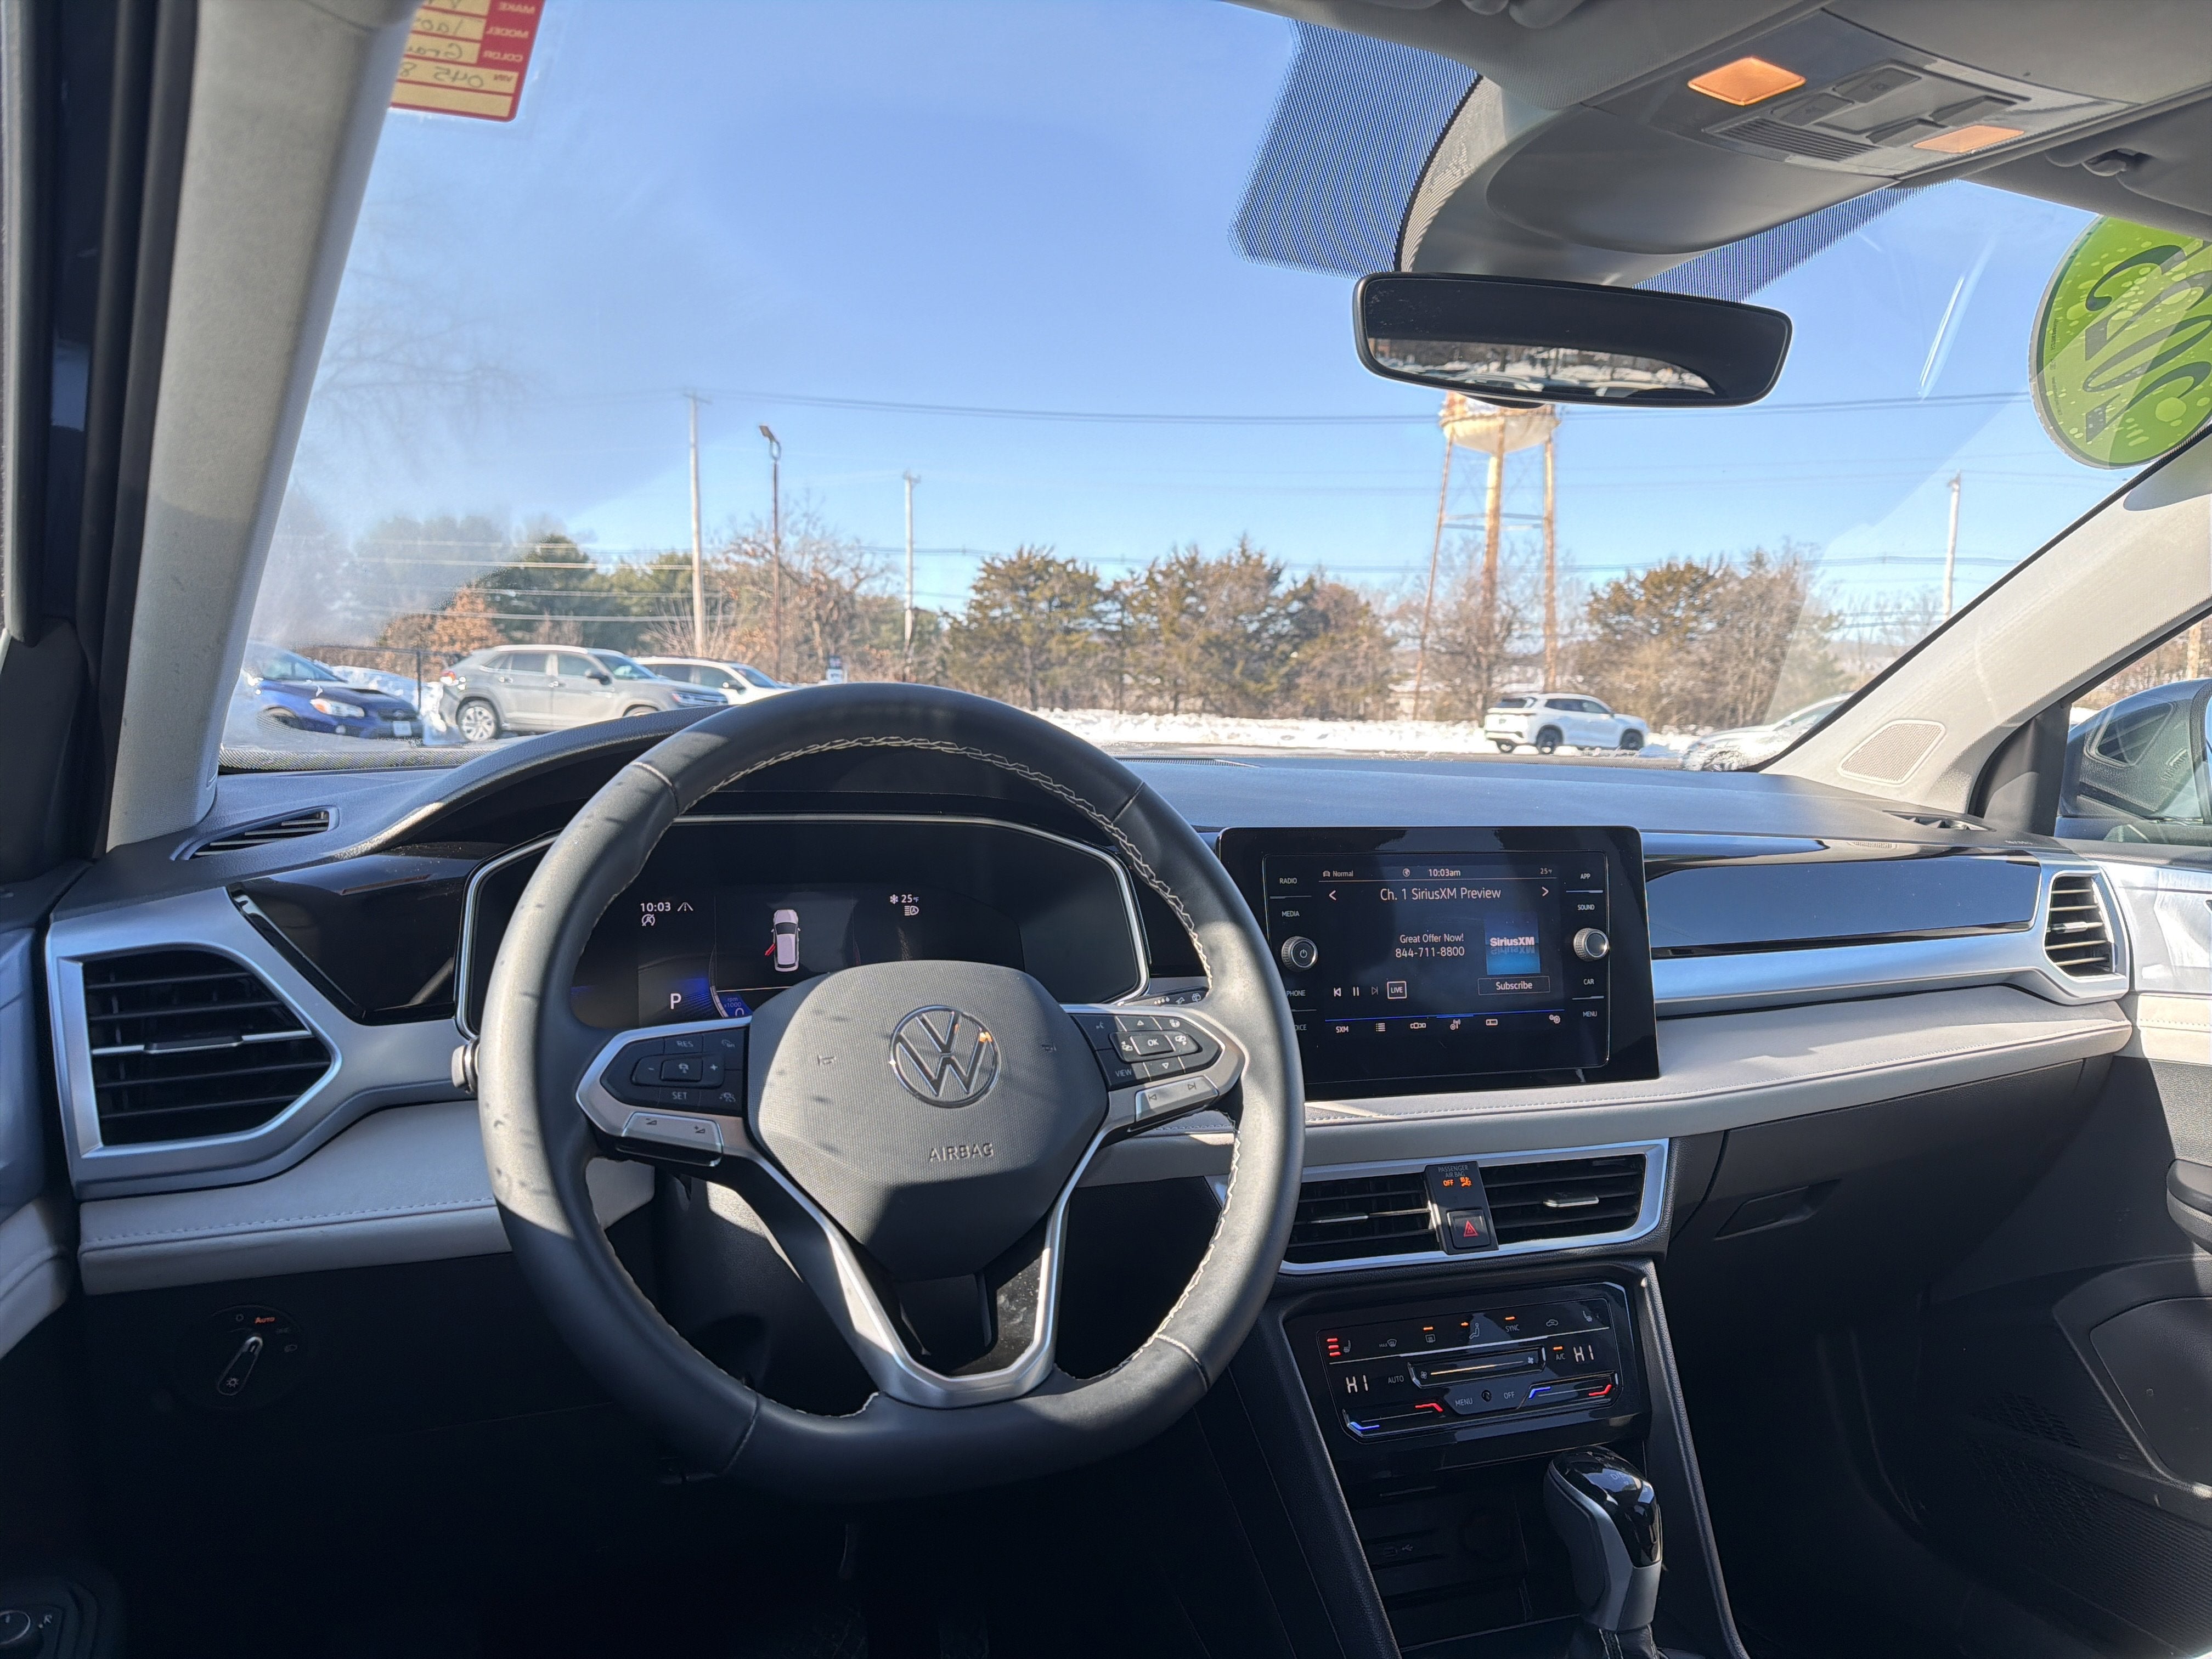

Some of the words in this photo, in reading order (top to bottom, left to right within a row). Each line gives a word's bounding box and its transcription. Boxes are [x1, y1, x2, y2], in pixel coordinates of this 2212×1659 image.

[1428, 868, 1461, 877] 10:03am
[1380, 888, 1398, 900] Ch.
[1402, 888, 1407, 900] 1
[1412, 887, 1457, 900] SiriusXM
[1460, 887, 1501, 899] Preview
[640, 902, 671, 912] 10:03
[1400, 934, 1421, 944] Great
[1422, 933, 1441, 943] Offer
[1443, 933, 1464, 942] Now!
[1489, 936, 1535, 947] SiriusXM
[1395, 946, 1465, 958] 844-711-8800
[1496, 980, 1533, 990] Subscribe
[669, 994, 682, 1009] P
[1147, 1039, 1159, 1047] OK
[1115, 1069, 1133, 1077] VIEW
[672, 1091, 687, 1099] SET
[929, 1143, 995, 1163] AIRBAG
[1505, 1324, 1520, 1333] SYNC
[1388, 1375, 1404, 1384] AUTO
[1503, 1391, 1515, 1400] OFF
[1455, 1398, 1473, 1407] MENU
